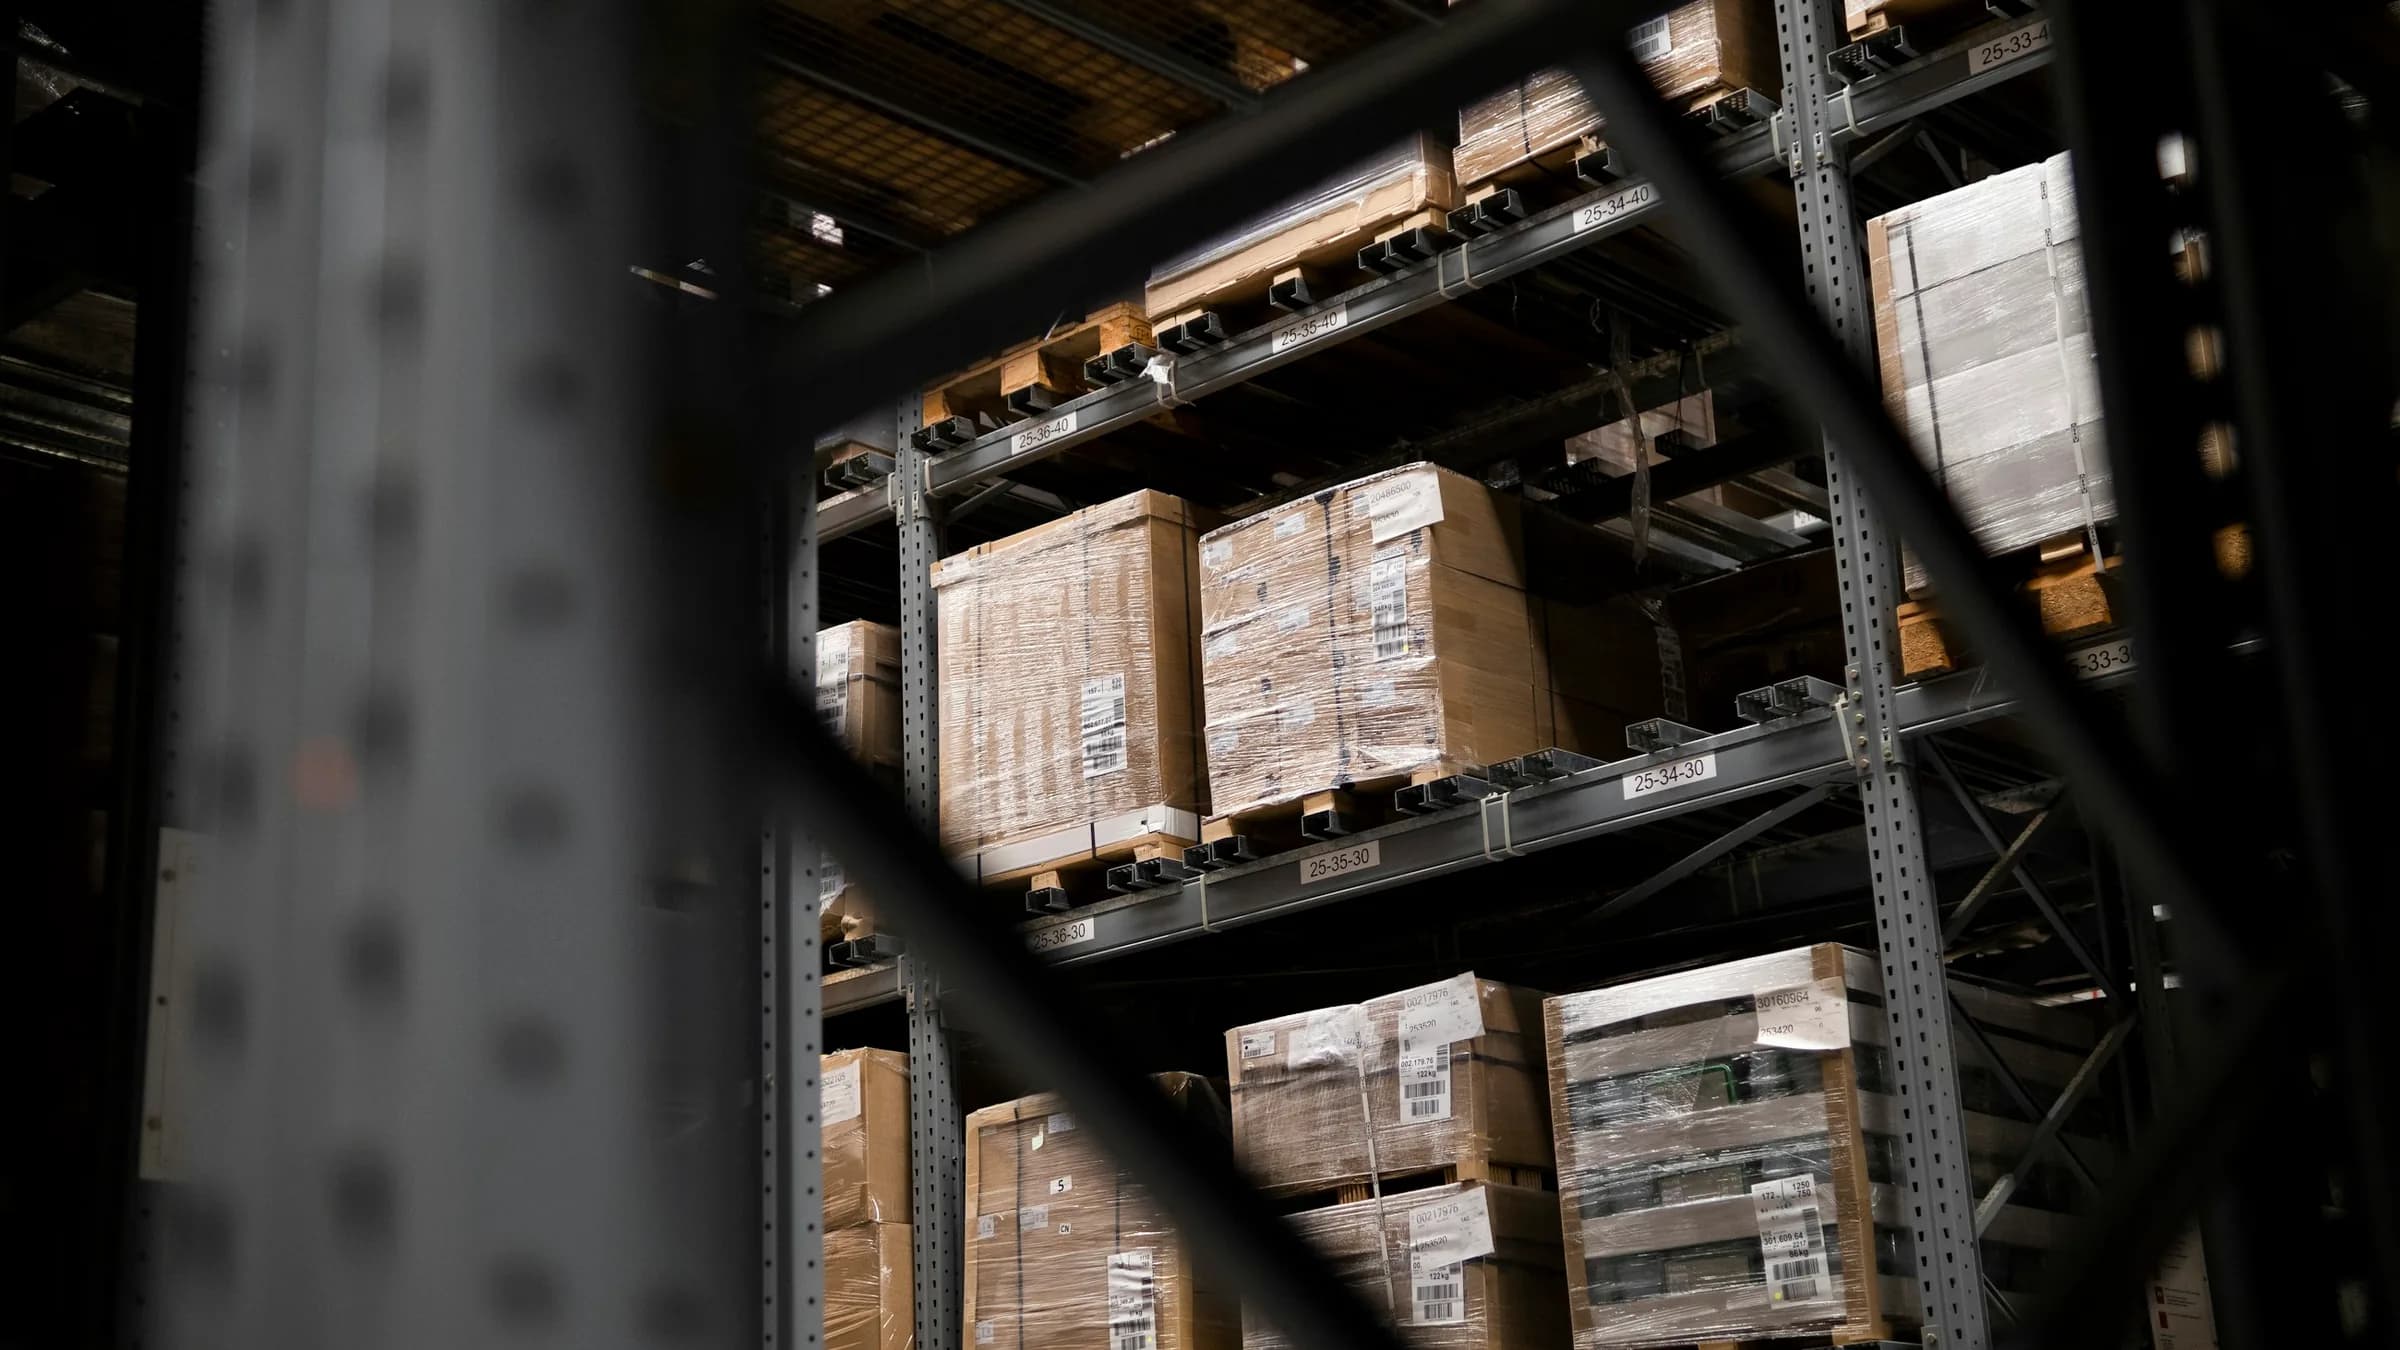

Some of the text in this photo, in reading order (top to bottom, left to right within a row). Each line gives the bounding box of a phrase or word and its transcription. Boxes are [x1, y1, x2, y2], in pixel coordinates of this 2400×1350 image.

[1982, 24, 2048, 64] 25-33-4
[1584, 186, 1649, 225] 25-34-40
[1281, 312, 1338, 346] 25-35-40
[1019, 418, 1069, 449] 25-36-40
[2068, 645, 2131, 674] 5-33-3
[1634, 759, 1704, 793] 25-34-30
[1310, 848, 1370, 878] 25-35-30
[1034, 922, 1086, 949] 25-36-30
[1757, 990, 1809, 1009] 30160964
[1058, 1179, 1065, 1192] 5
[1762, 1191, 1775, 1200] 172
[1792, 1179, 1810, 1191] 1250
[1796, 1188, 1812, 1199] 750
[1060, 1225, 1070, 1233] CN
[1763, 1231, 1804, 1246] 301.609.64
[1429, 1272, 1450, 1281] 122kg
